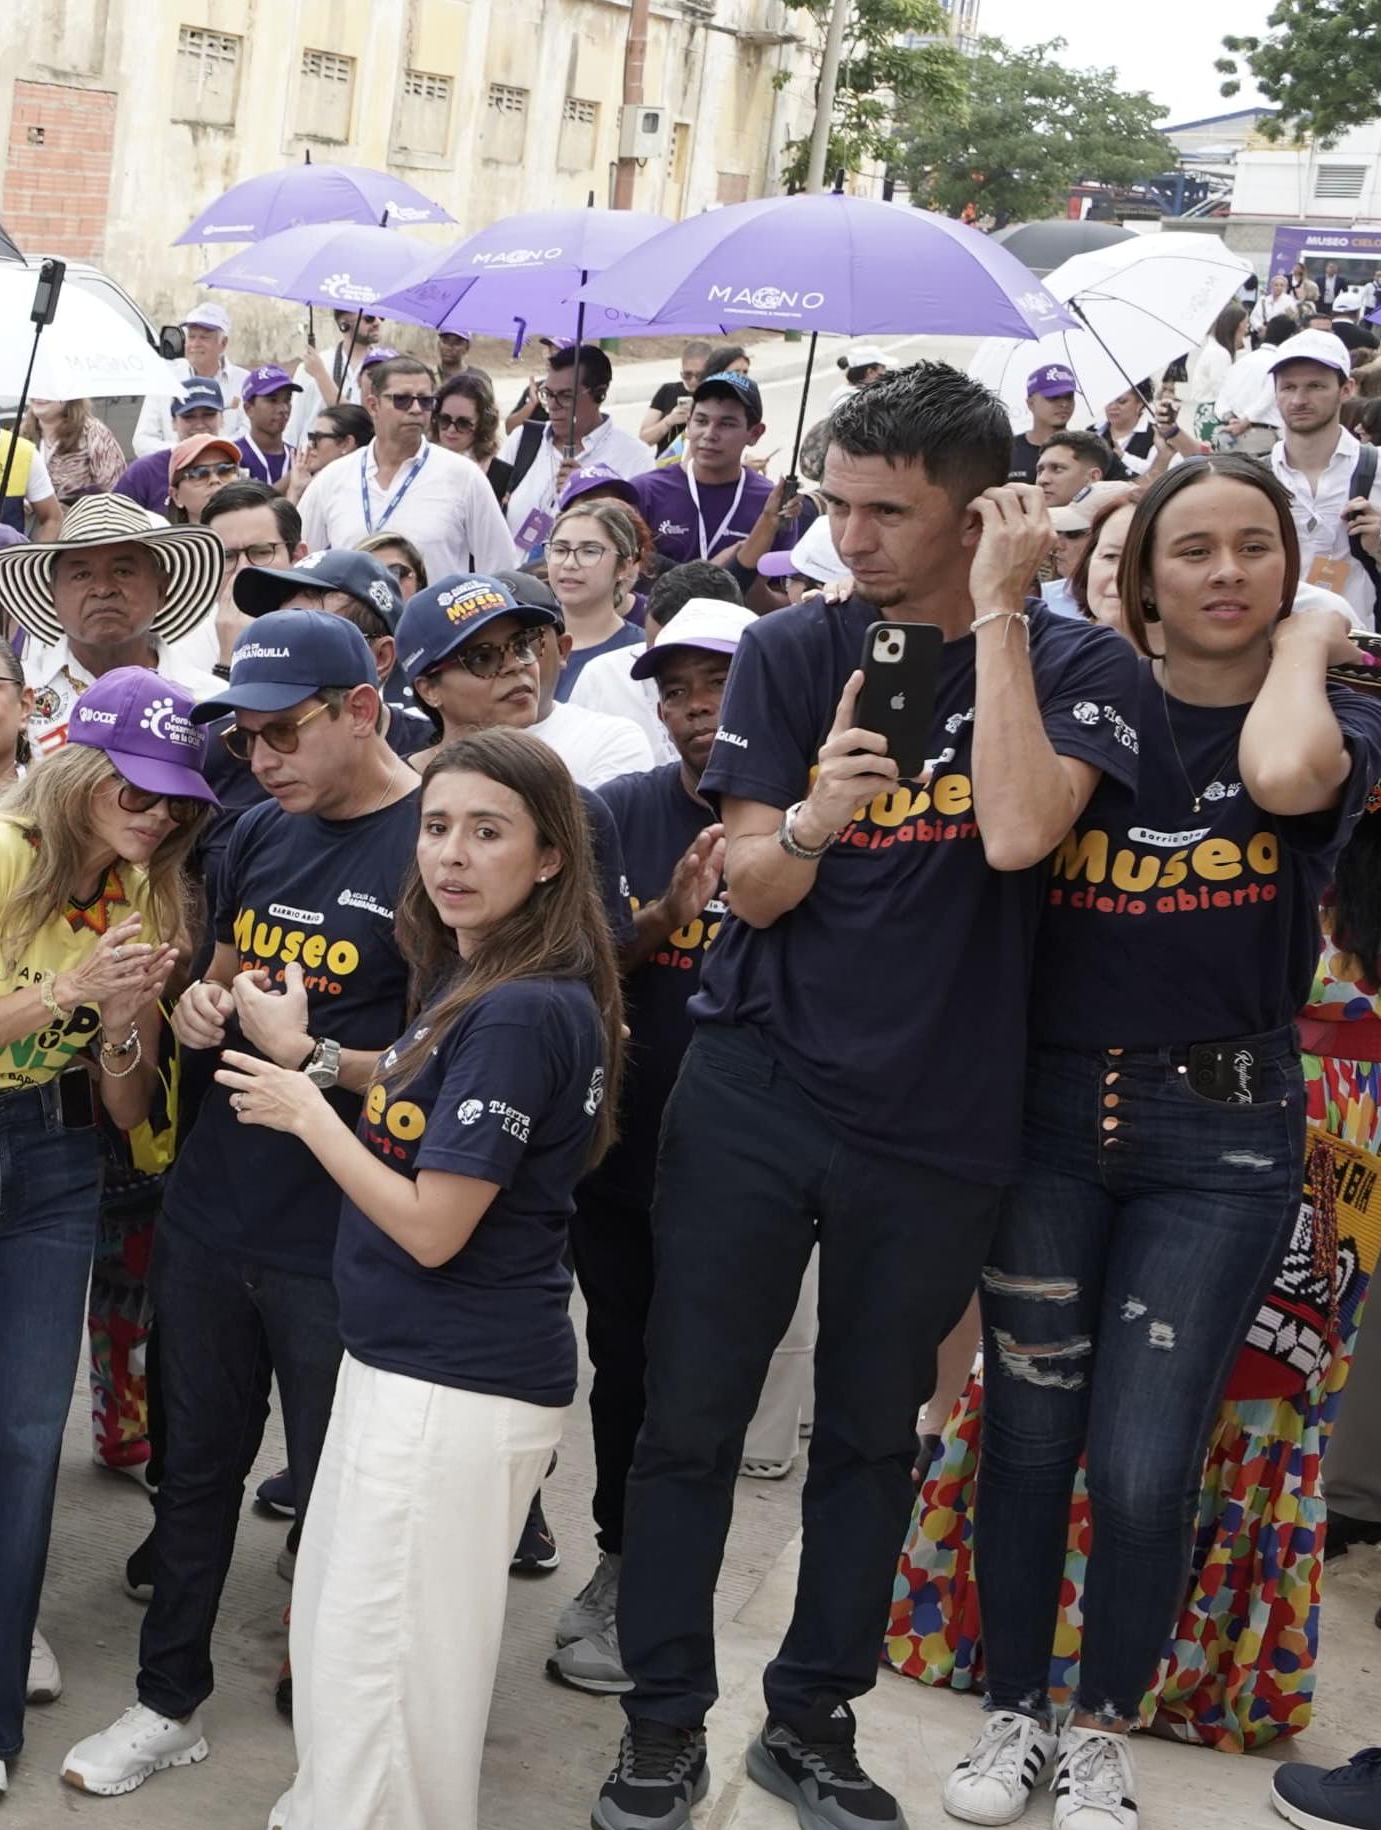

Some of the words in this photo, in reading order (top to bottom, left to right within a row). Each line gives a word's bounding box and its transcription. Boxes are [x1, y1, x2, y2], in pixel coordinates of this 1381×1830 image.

[1305, 235, 1349, 247] MUSEO
[472, 248, 563, 265] MAGNO
[708, 285, 824, 309] MAGNO
[92, 712, 118, 725] OCDE
[1053, 827, 1280, 893] Museo
[1070, 886, 1147, 915] cielo
[1156, 882, 1277, 912] abierto
[233, 906, 360, 976] Museo
[489, 1100, 531, 1128] Tierra
